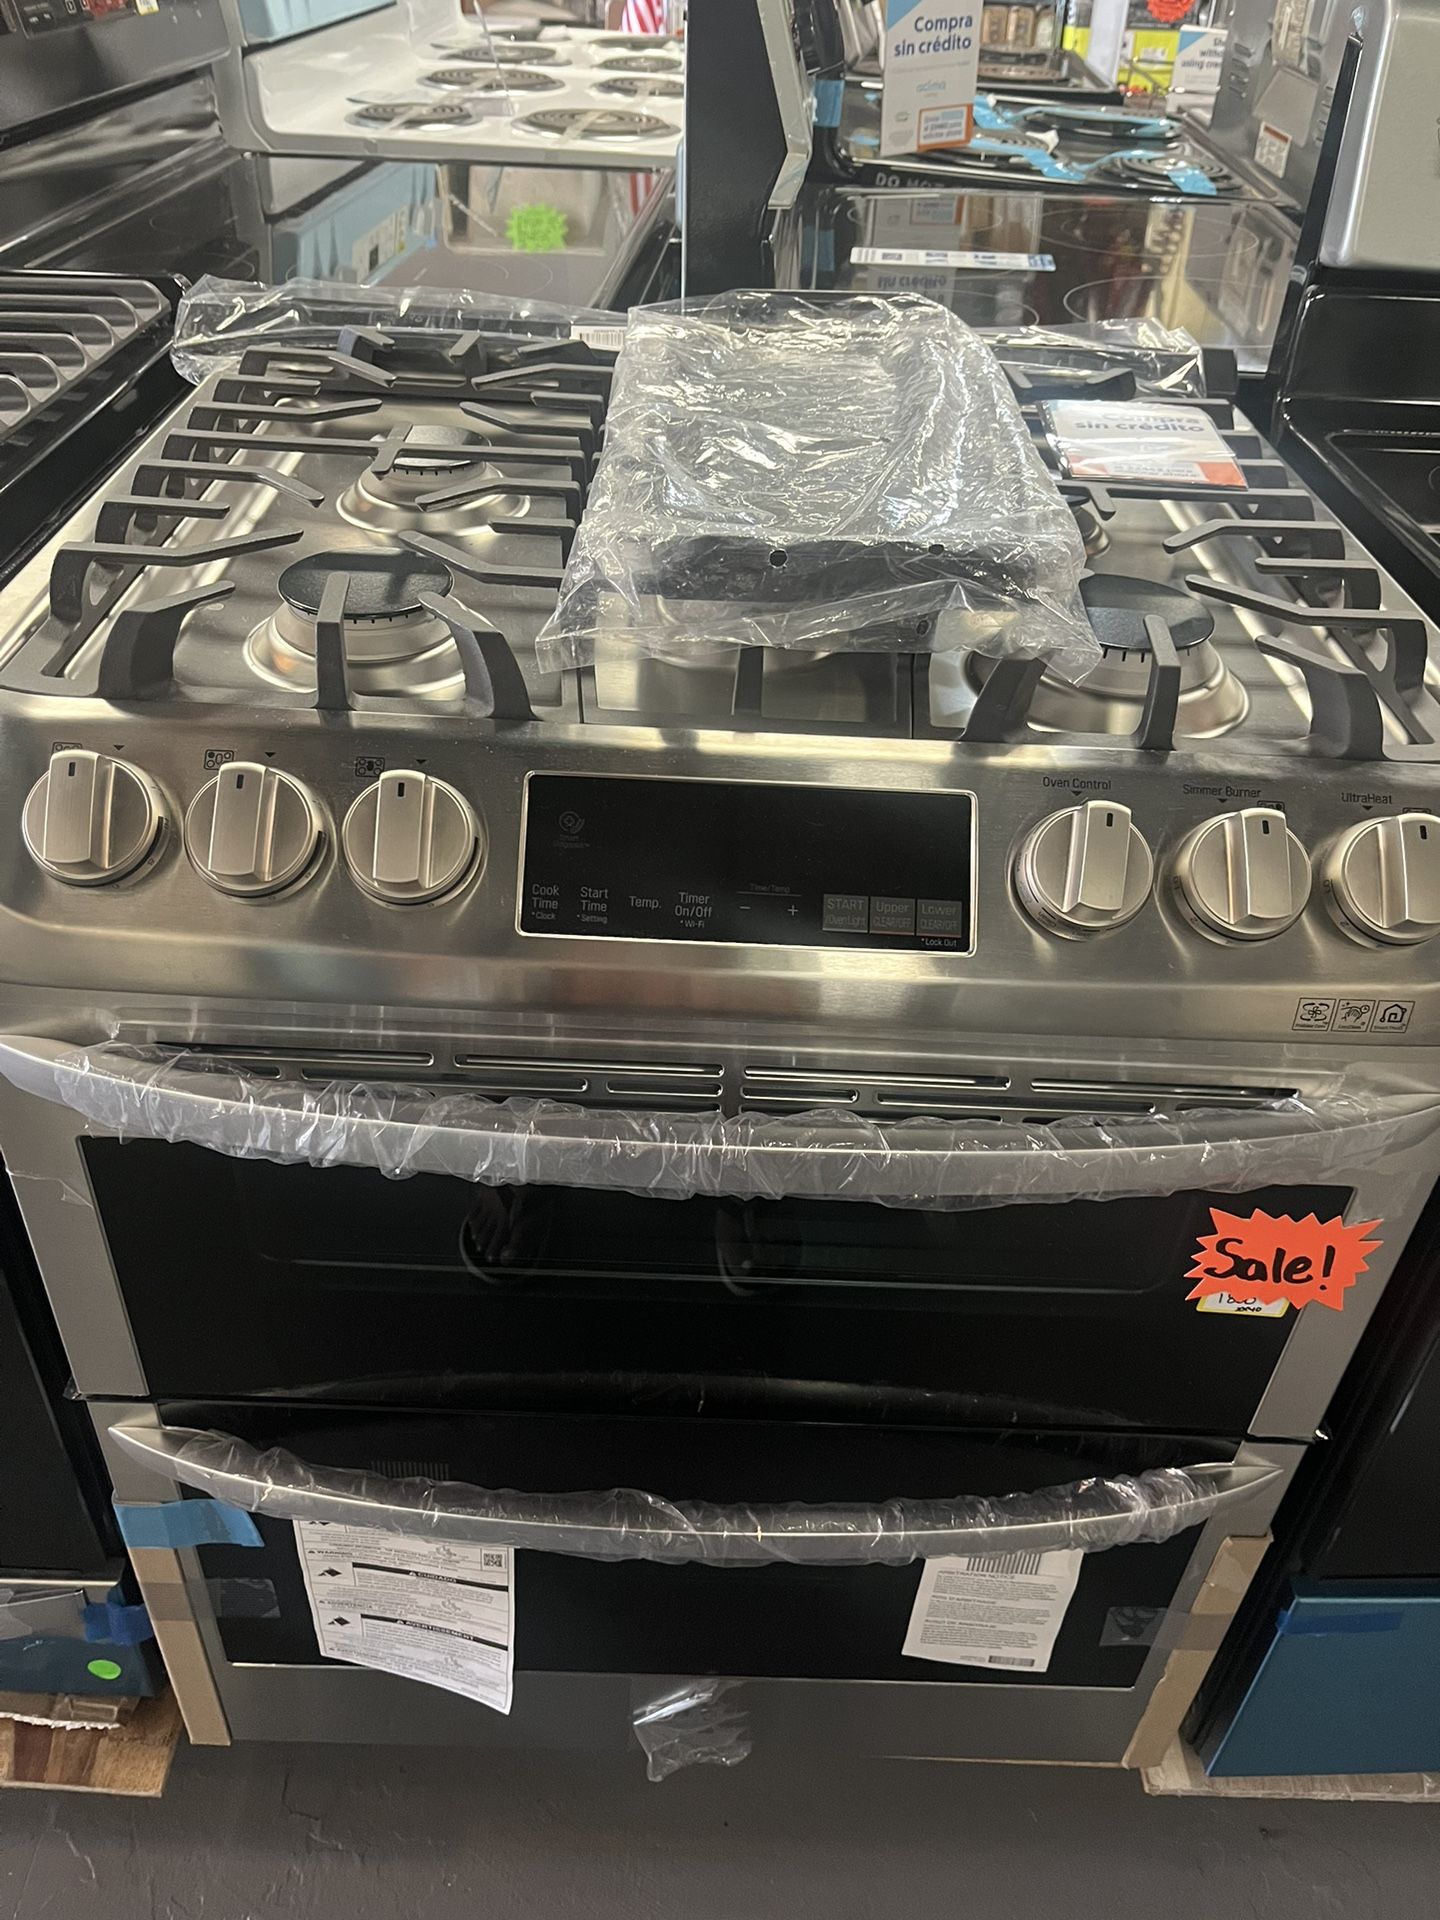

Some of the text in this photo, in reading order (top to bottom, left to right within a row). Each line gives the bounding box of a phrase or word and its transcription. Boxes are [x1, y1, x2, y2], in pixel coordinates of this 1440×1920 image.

[914, 15, 973, 32] Compra
[894, 34, 972, 57] sin crédito
[875, 172, 901, 188] DO
[1075, 422, 1205, 433] sin crédito
[1042, 776, 1112, 791] Oven Control
[1183, 784, 1262, 799] Simmer Burner
[1341, 792, 1393, 805] UltraHeat
[531, 883, 560, 897] Cook
[580, 886, 609, 899] Start
[531, 896, 559, 910] Time
[629, 895, 662, 910] Temp.
[678, 891, 711, 905] Timer
[827, 898, 865, 911] START
[580, 899, 608, 913] Time
[674, 904, 713, 918] On/Off
[876, 901, 909, 914] Upper
[921, 903, 957, 916] Lower
[924, 938, 958, 947] Lock Out
[1203, 1237, 1336, 1291] Sale!
